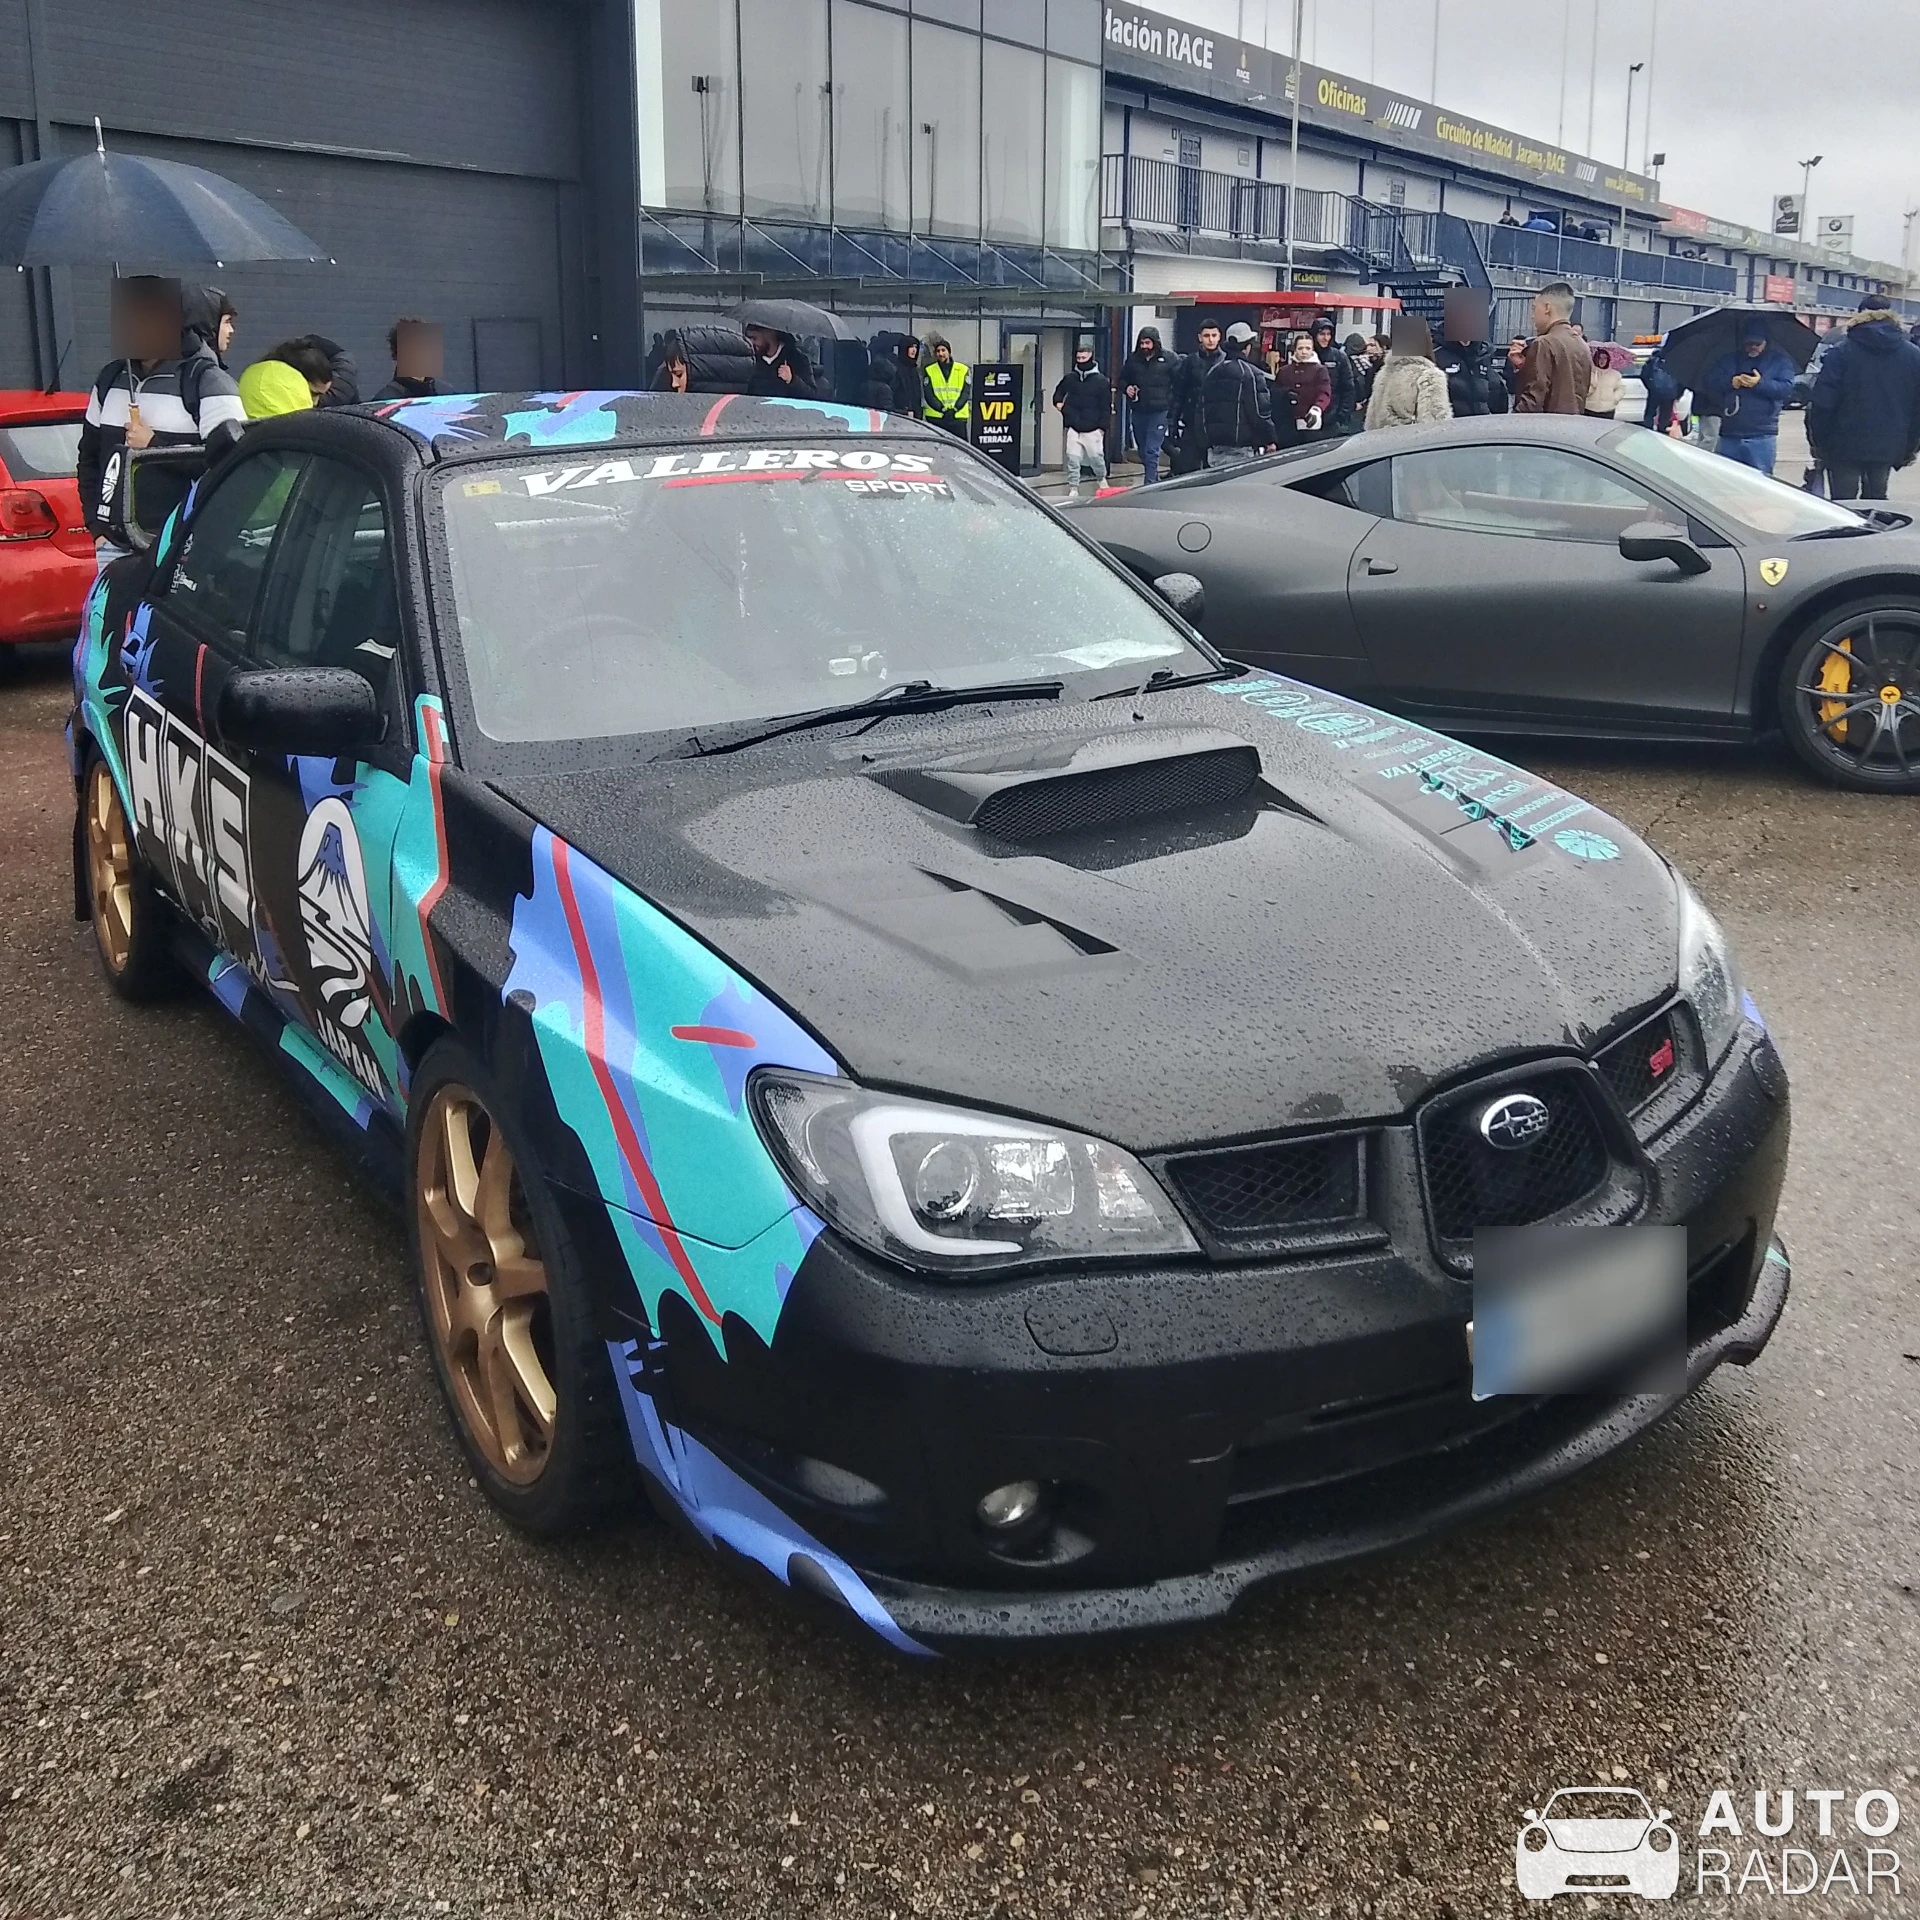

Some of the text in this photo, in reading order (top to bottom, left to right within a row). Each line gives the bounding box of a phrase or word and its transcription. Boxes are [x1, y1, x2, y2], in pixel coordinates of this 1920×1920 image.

[1166, 27, 1214, 70] RACE
[1318, 78, 1367, 116] Oficinas
[1436, 116, 1472, 146] Circuito
[1472, 128, 1483, 150] de
[1484, 131, 1513, 159] Madrid
[1546, 151, 1566, 174] RACE
[980, 402, 1014, 420] VIP
[983, 426, 1003, 434] SALA
[979, 435, 1013, 443] TERRAZA
[518, 449, 935, 497] VALLEROS
[844, 479, 950, 496] SPORT
[1377, 745, 1463, 779] VALLEROS
[127, 710, 252, 929] HKS
[315, 1008, 387, 1103] JAPAN
